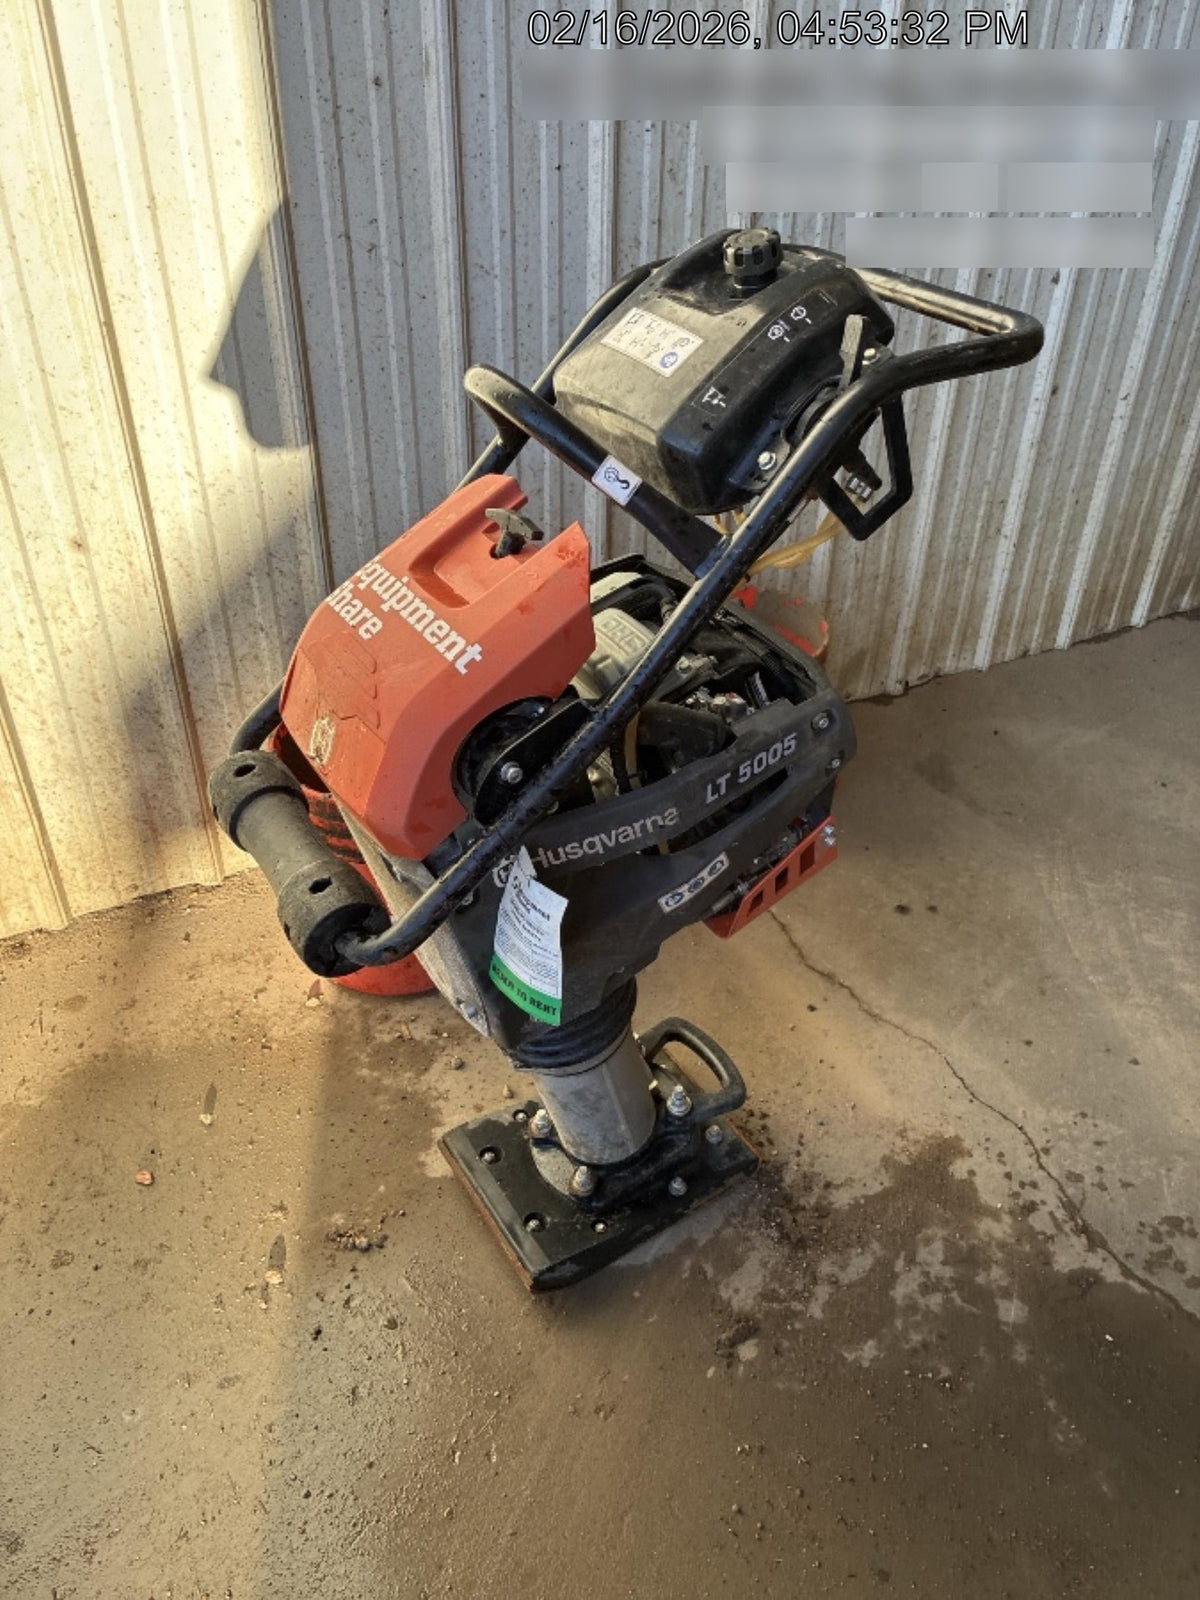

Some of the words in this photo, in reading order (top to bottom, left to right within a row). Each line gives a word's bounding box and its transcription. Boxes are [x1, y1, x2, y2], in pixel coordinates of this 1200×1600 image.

[705, 772, 742, 804] LT
[737, 733, 798, 784] 5005
[530, 806, 680, 869] Husqvarna
